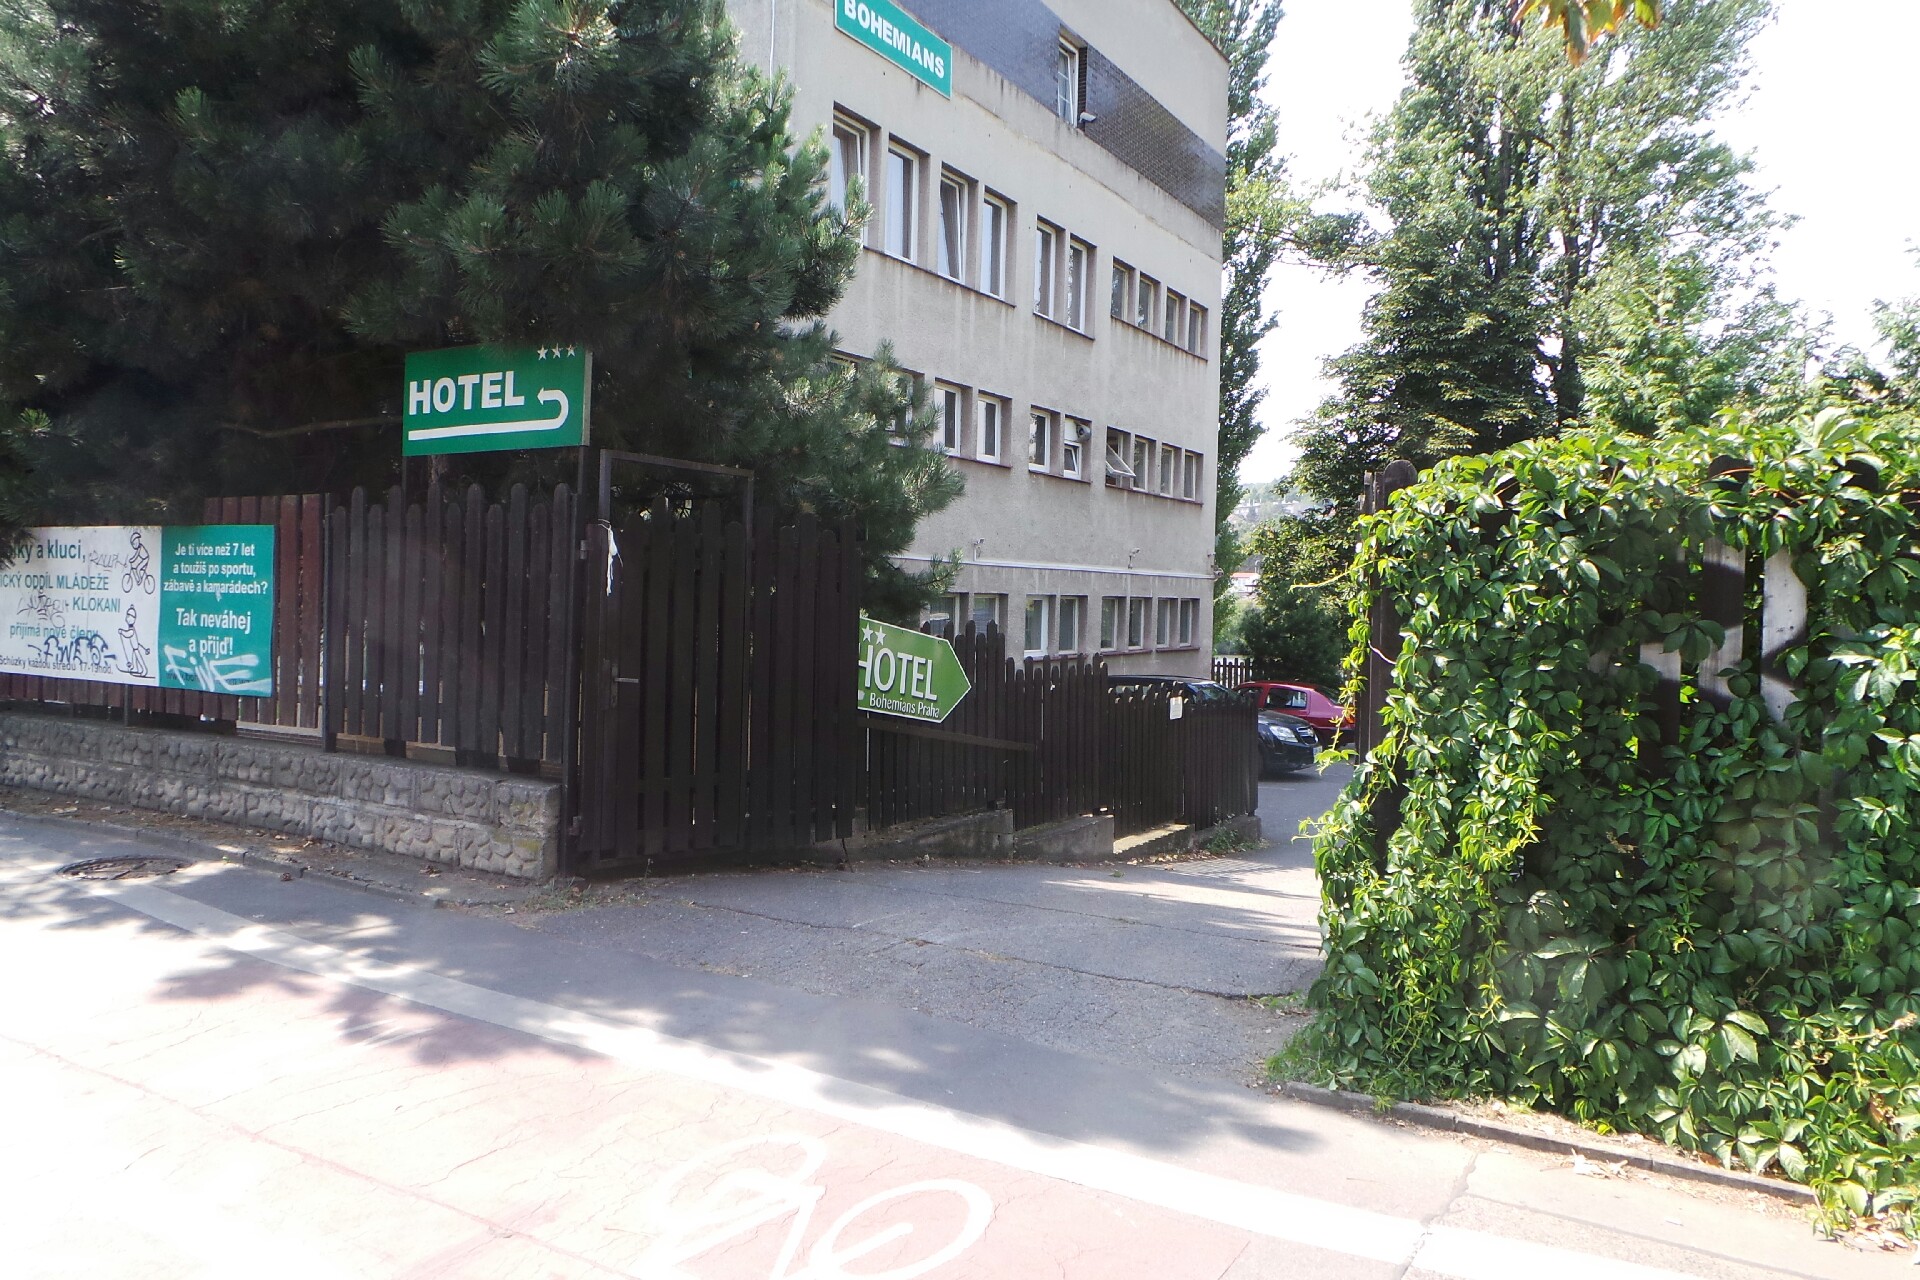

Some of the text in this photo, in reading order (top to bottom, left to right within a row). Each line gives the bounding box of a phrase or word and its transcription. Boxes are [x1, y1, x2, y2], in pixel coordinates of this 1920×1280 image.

[844, 0, 945, 79] BOHEMIANS
[409, 370, 525, 416] HOTEL
[37, 544, 44, 559] a
[47, 539, 86, 563] kluci,
[175, 542, 255, 557] Je ti více než 7 let
[57, 573, 109, 590] MLÁDEŽE
[173, 561, 256, 578] a toužíš po sportu,
[163, 578, 268, 595] zábavě a kamarádech?
[73, 597, 120, 613] KLOKANI
[10, 622, 41, 639] přijímá
[176, 608, 251, 635] Tak neváhej
[188, 635, 233, 659] a přijď!
[858, 642, 938, 701] HOTEL
[869, 692, 940, 718] Bohemians Praha
